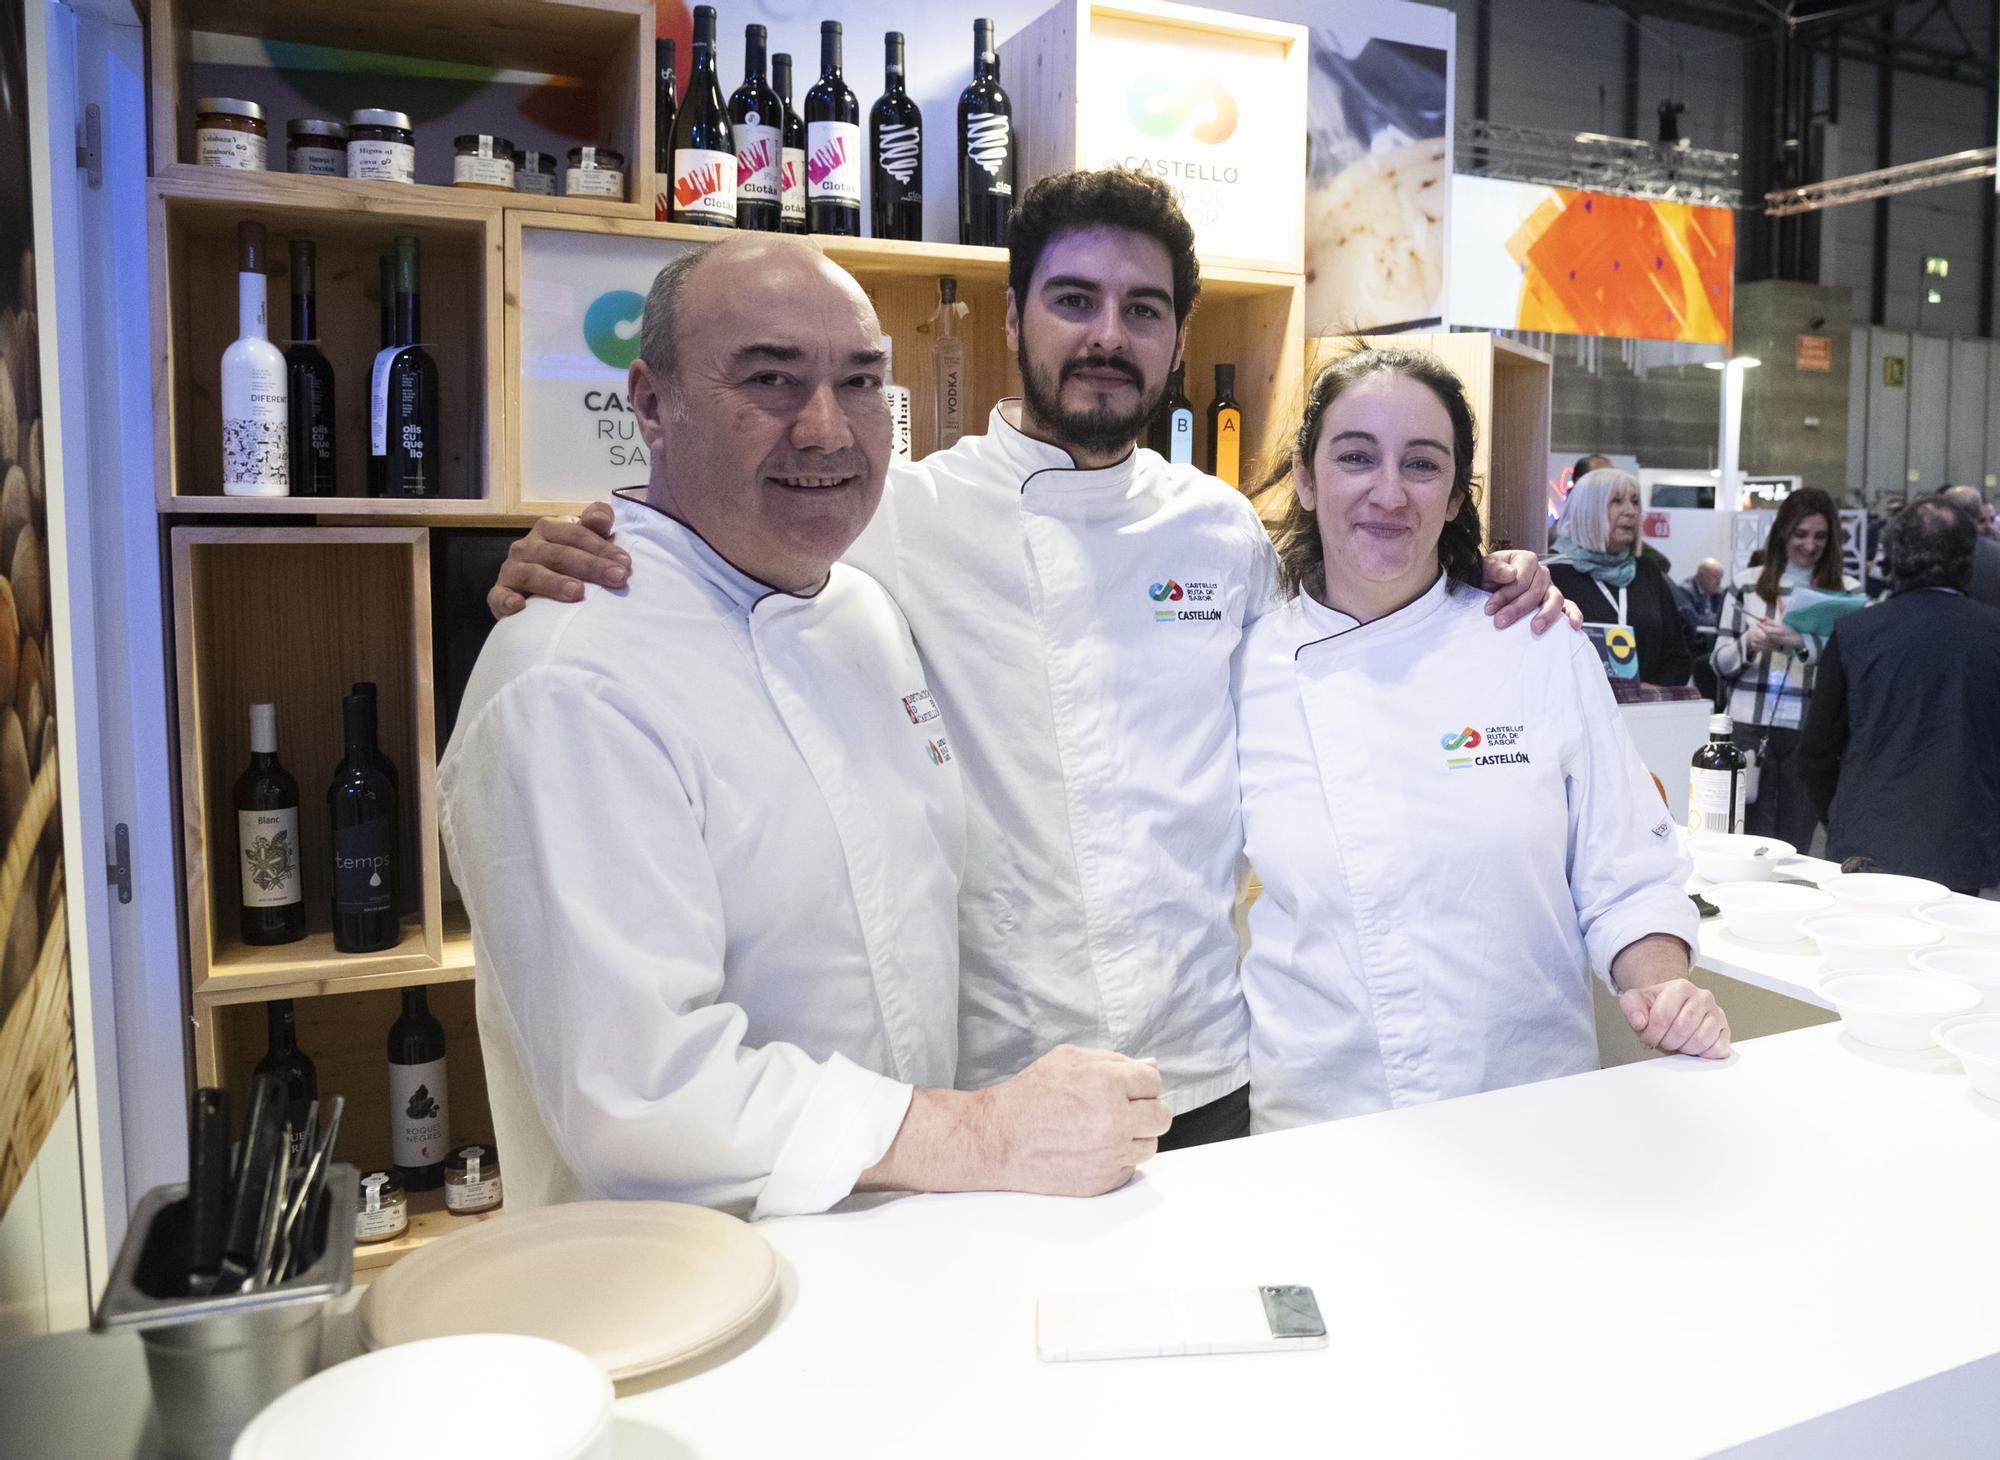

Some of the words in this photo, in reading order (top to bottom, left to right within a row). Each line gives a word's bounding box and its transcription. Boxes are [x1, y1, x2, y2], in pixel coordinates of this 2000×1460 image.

[781, 202, 806, 214] lotàs
[947, 371, 958, 415] VODKA
[402, 425, 422, 434] olis
[597, 419, 635, 441] RU
[1178, 418, 1189, 432] B
[1223, 418, 1236, 432] A
[402, 433, 417, 441] cu
[402, 440, 424, 449] que
[409, 449, 423, 458] llo
[1177, 608, 1222, 621] CASTELLÓN
[1486, 733, 1508, 741] RUTA
[1487, 739, 1517, 747] SABOR
[1474, 751, 1531, 766] CASTELLÓN
[257, 815, 280, 825] Blanc
[335, 850, 391, 871] temps
